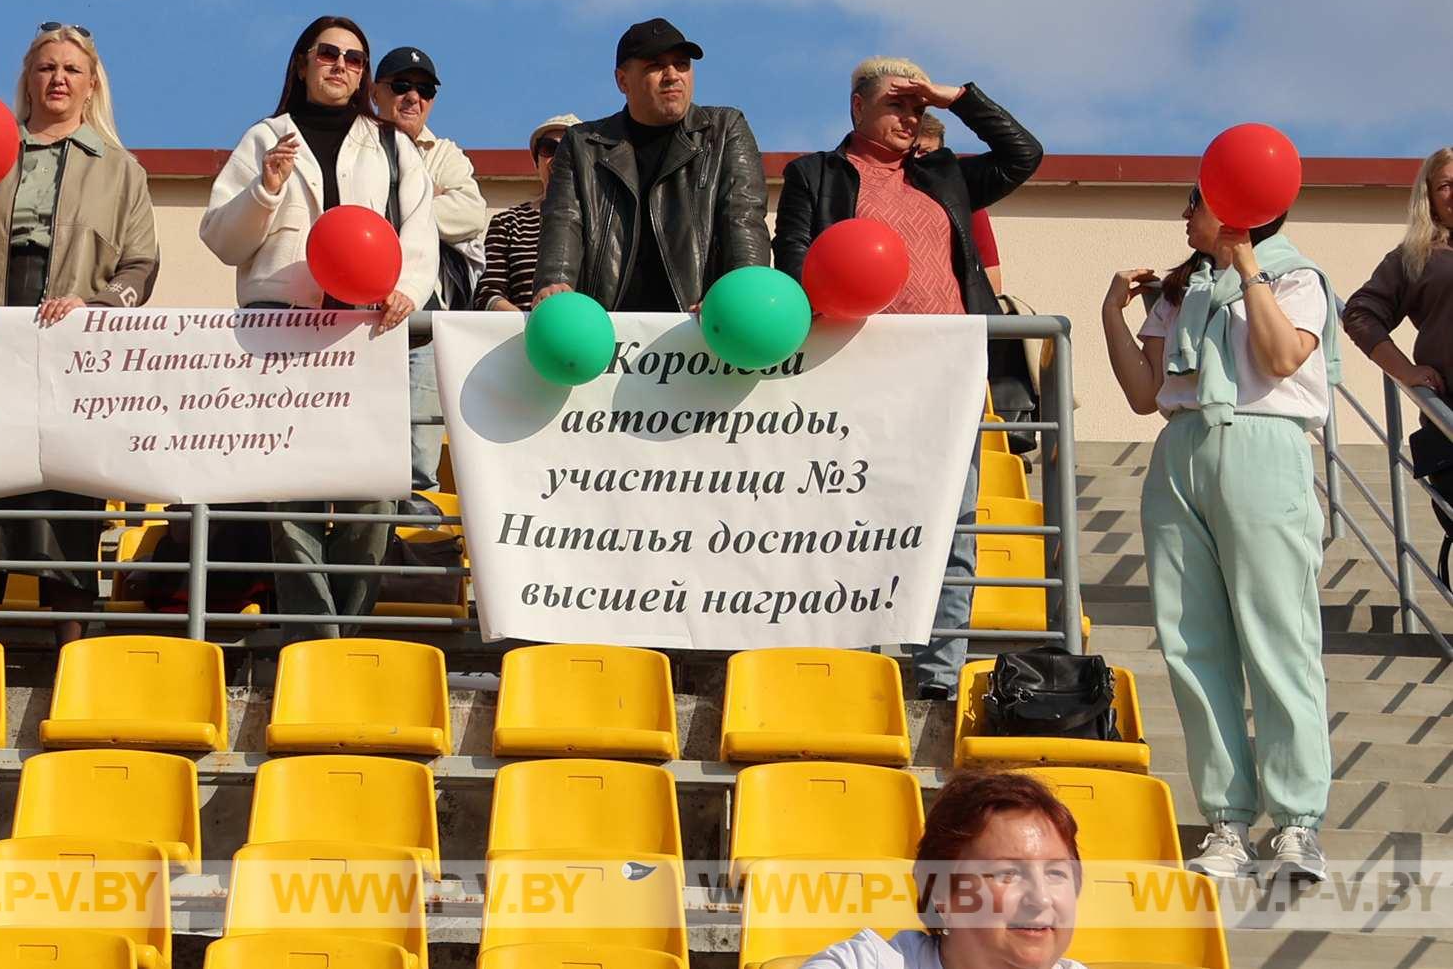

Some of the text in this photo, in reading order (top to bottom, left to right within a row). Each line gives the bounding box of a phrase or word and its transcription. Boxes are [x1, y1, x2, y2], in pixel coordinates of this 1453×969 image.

[82, 311, 339, 337] Наша участница
[65, 347, 357, 375] №3 Наталья рулит
[73, 386, 352, 420] круто, побеждает
[558, 399, 849, 444] автострады,
[127, 426, 294, 456] за минуту!
[541, 459, 871, 502] участница №3
[495, 513, 922, 556] Наталья достойна
[521, 575, 899, 624] высшей награды!
